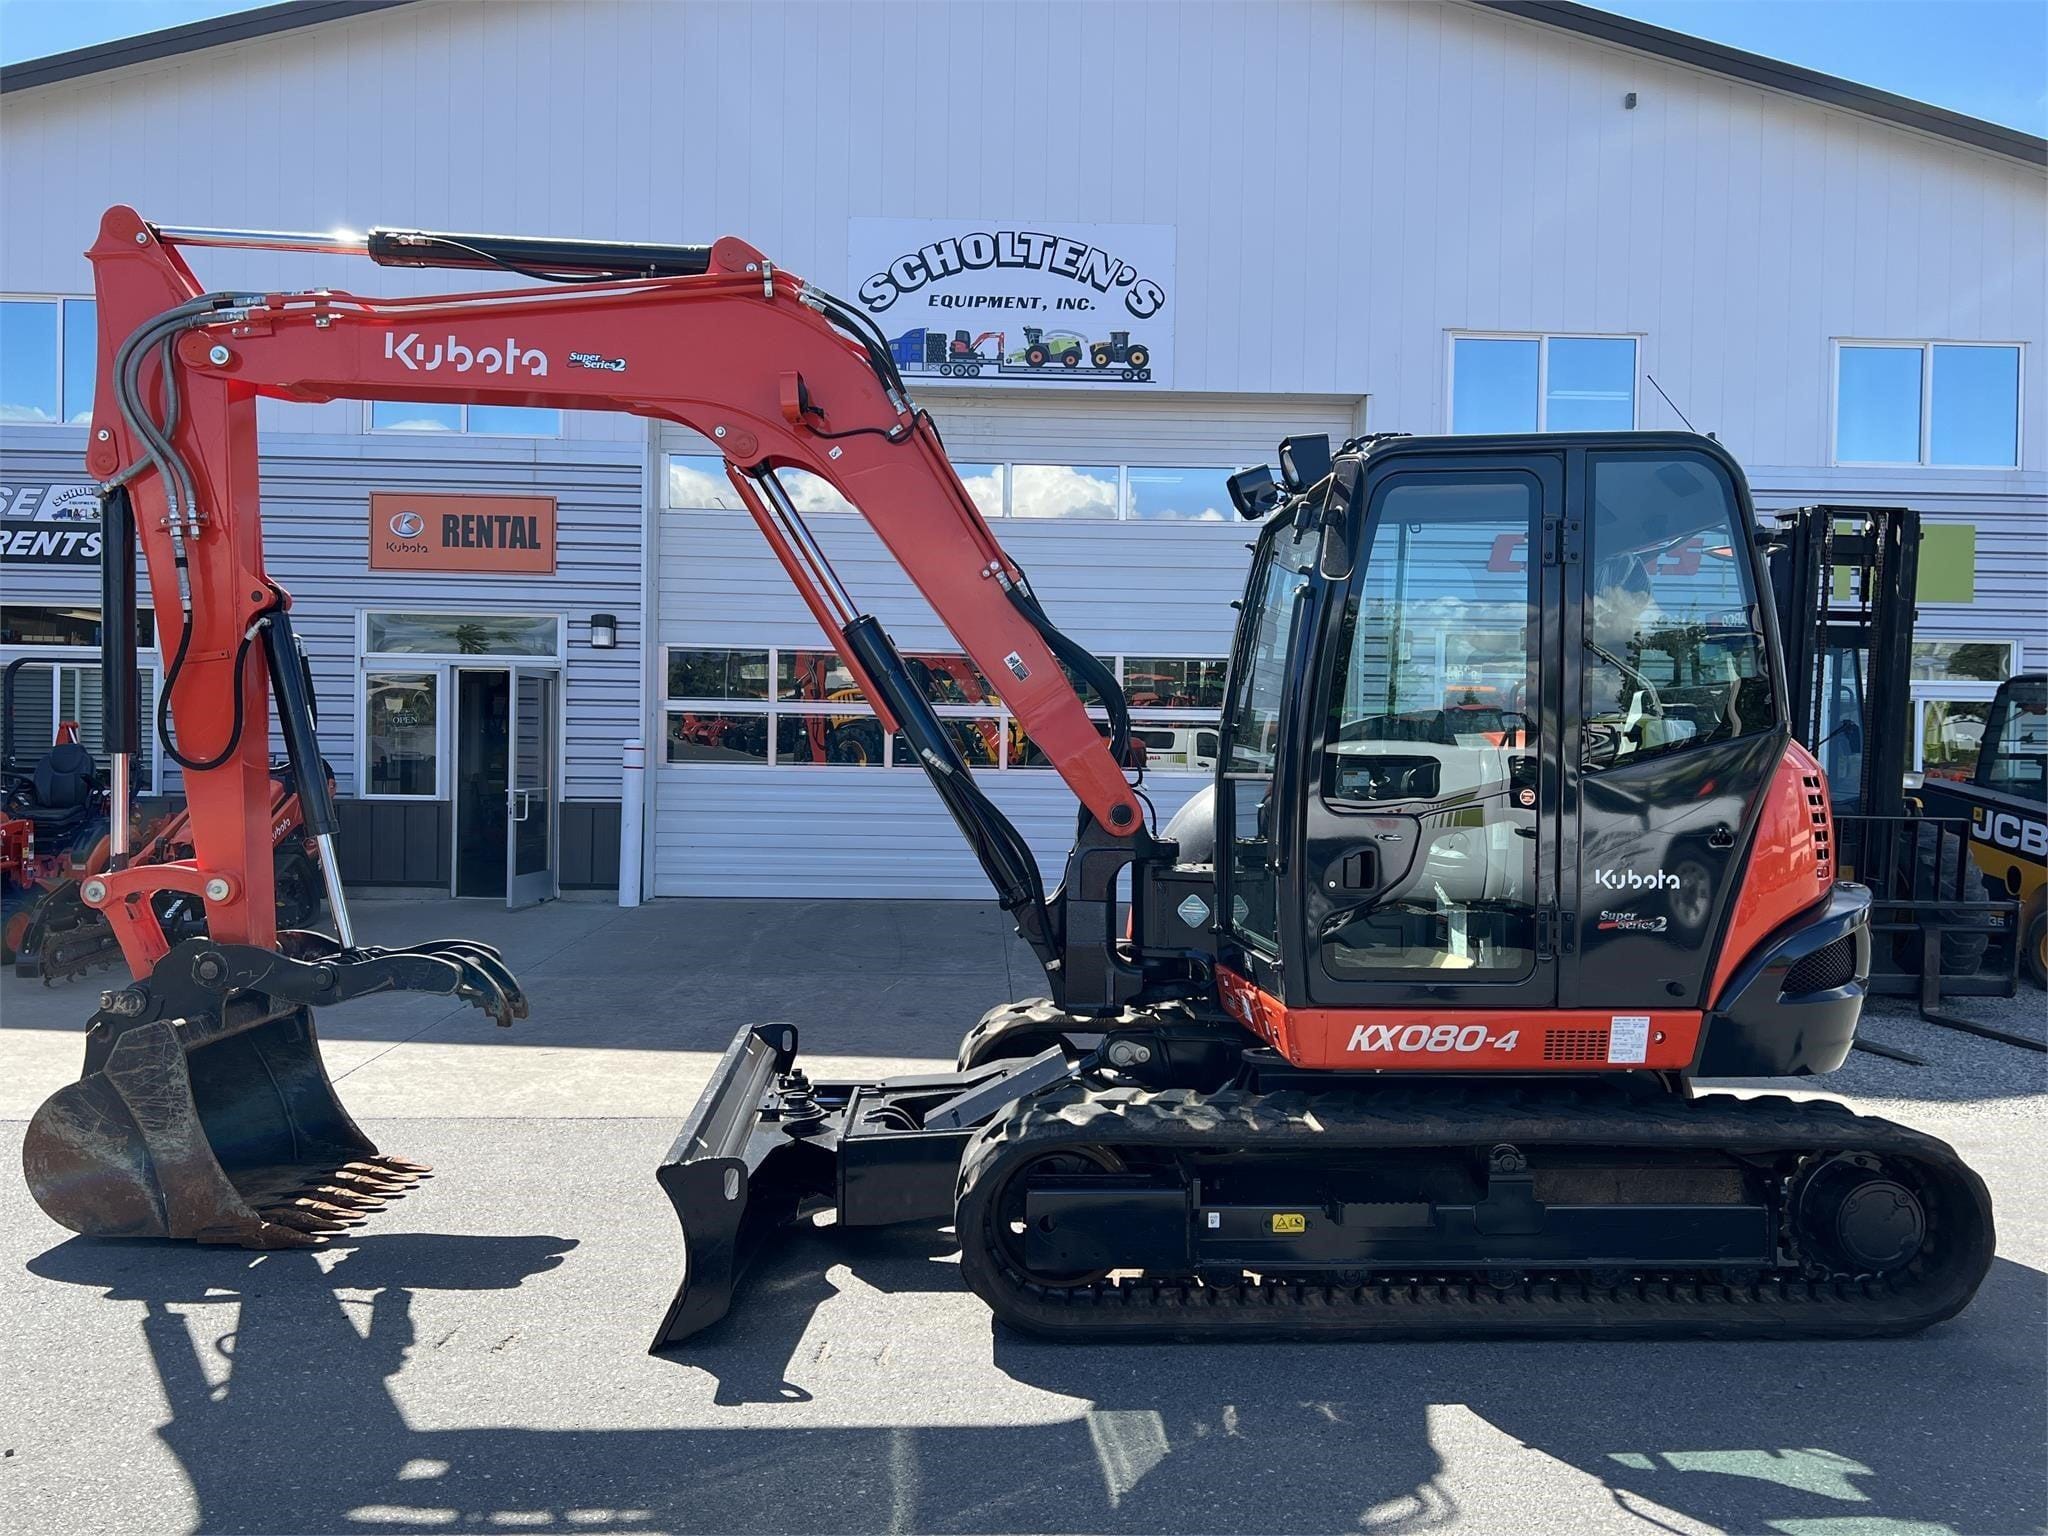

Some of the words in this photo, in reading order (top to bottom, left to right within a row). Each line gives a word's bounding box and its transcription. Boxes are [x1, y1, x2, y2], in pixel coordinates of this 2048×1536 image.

[858, 231, 1165, 319] SCHOLTEN'S
[928, 294, 1048, 311] EQUIPMENT,
[1056, 297, 1096, 310] INC.
[384, 331, 548, 376] Kubota
[569, 351, 601, 363] Super
[442, 514, 541, 549] RENTAL
[386, 541, 428, 553] Kubota
[392, 716, 418, 724] OPEN
[271, 818, 291, 842] ubota
[1972, 809, 2048, 857] JCB
[1595, 869, 1681, 889] Kubota
[1600, 910, 1637, 922] Super
[1347, 1024, 1520, 1052] KX080-4
